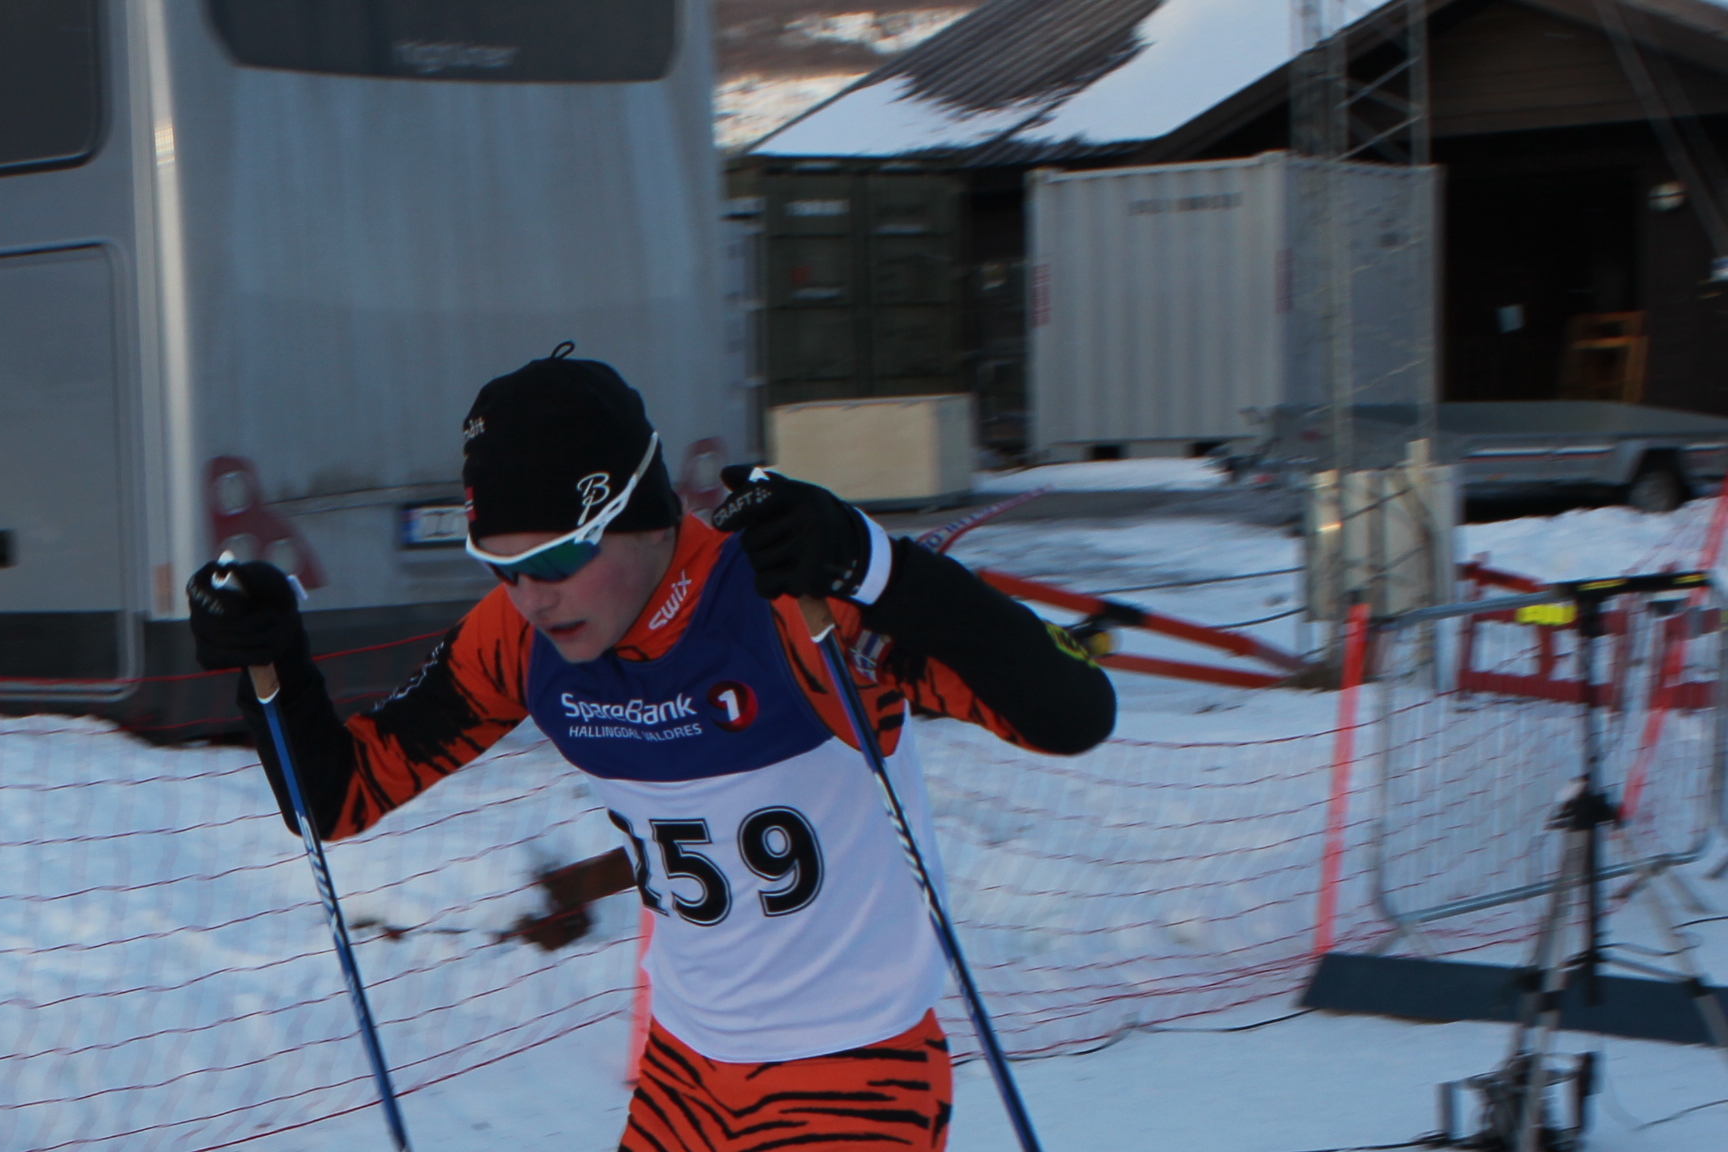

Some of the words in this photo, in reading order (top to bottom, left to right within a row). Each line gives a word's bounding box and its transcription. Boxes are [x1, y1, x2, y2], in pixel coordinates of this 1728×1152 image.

[714, 491, 754, 527] CRAFT
[560, 691, 699, 725] SpareBank
[568, 725, 642, 739] HALLINGDAL
[643, 723, 703, 742] VALDRES
